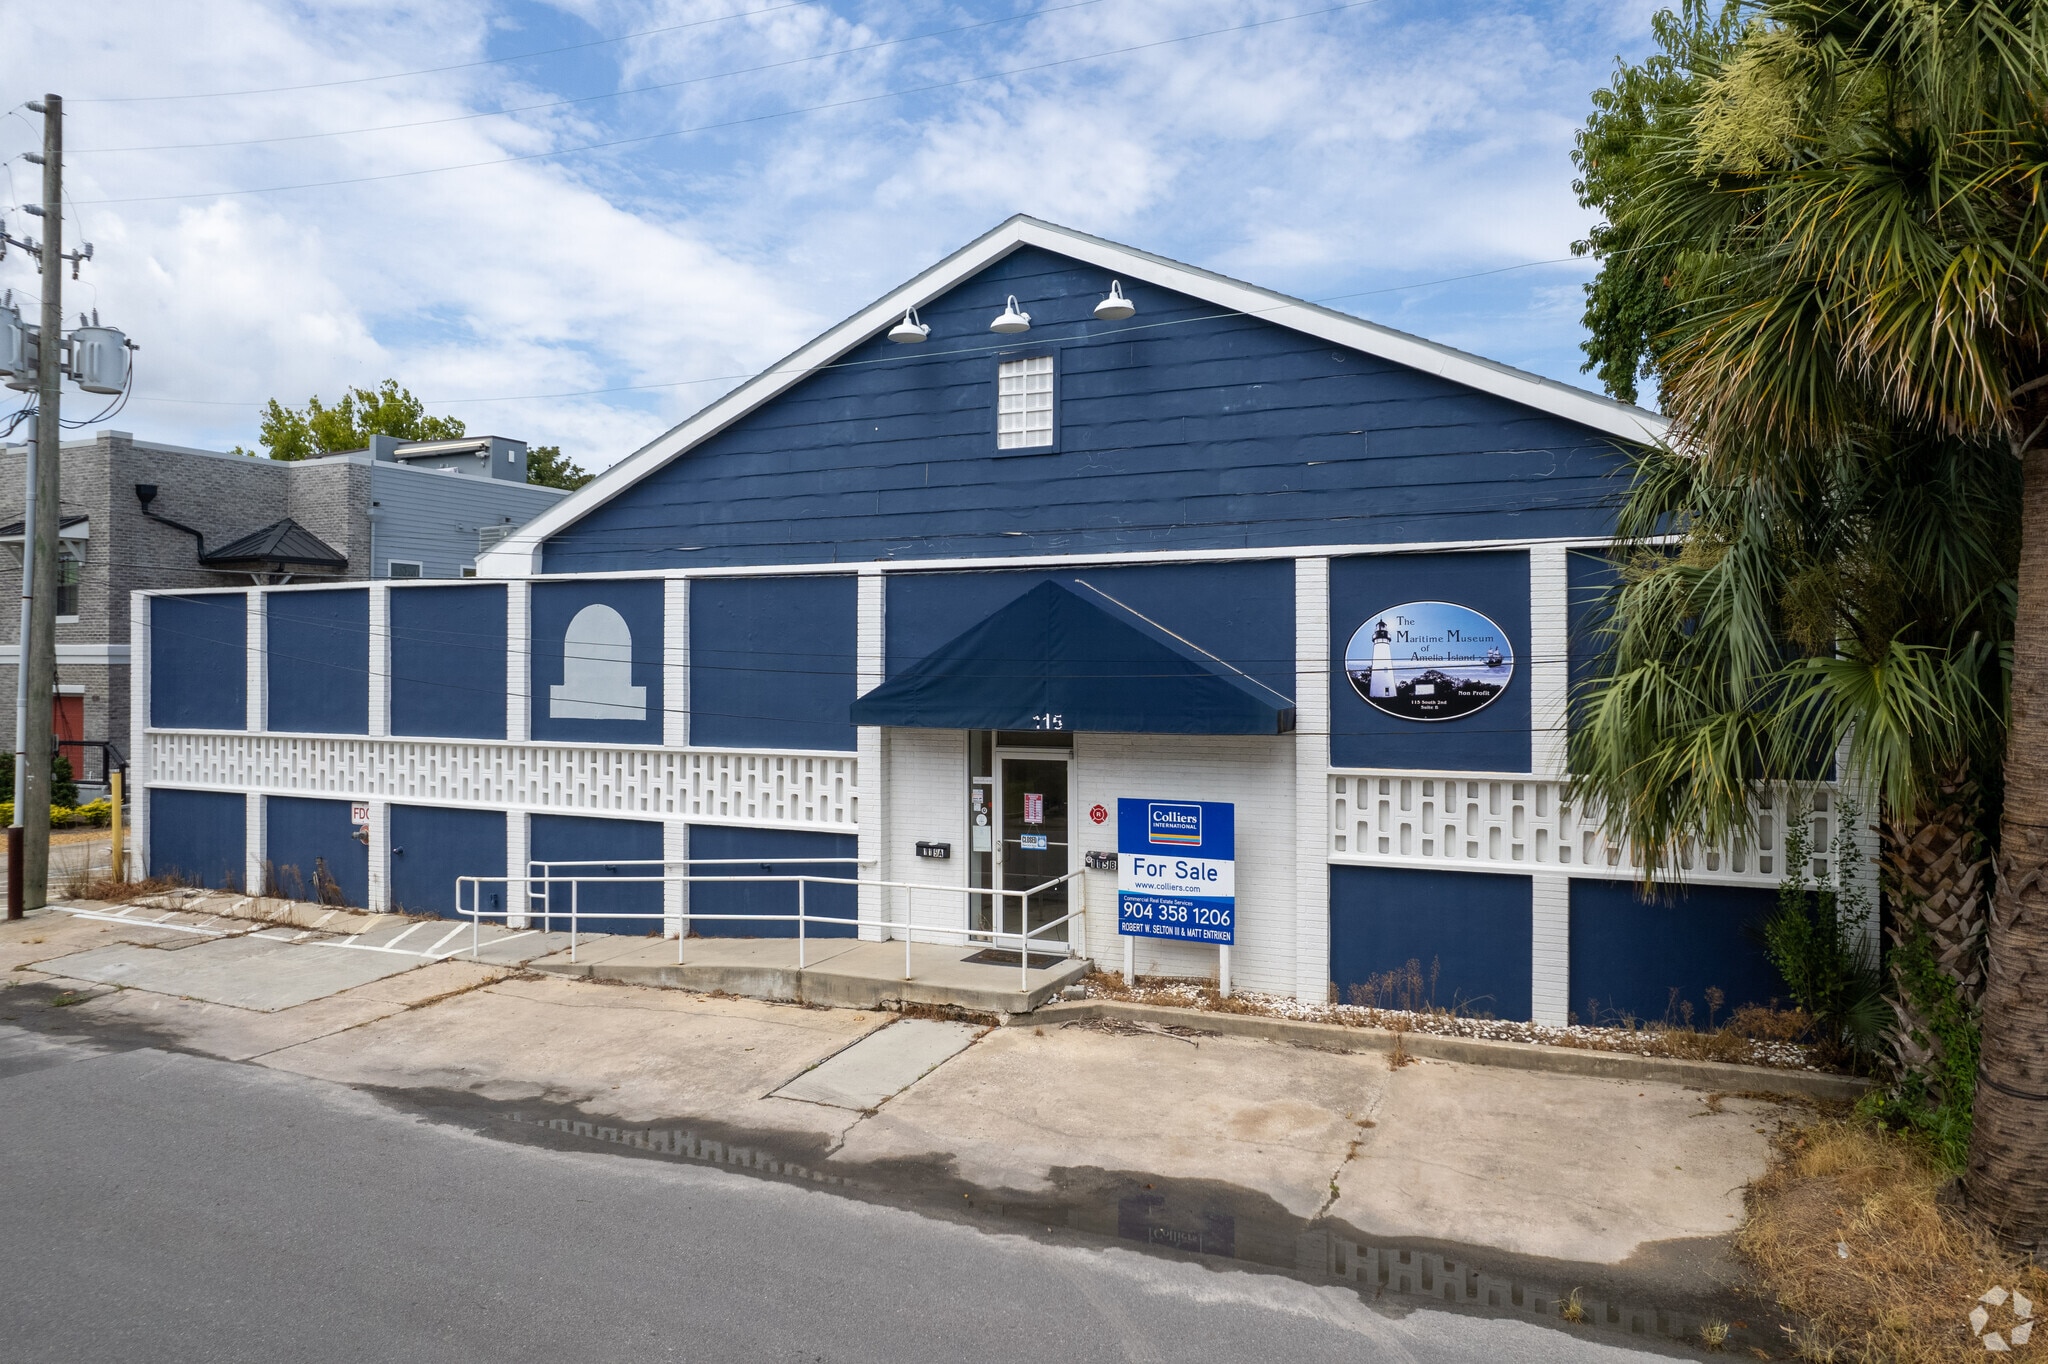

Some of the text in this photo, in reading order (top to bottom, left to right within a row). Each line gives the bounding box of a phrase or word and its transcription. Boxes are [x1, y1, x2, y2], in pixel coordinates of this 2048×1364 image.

[1396, 616, 1415, 626] The
[1396, 630, 1494, 642] Maritime Museum
[1410, 652, 1475, 661] Amelia Island
[1032, 713, 1062, 730] 115
[1153, 811, 1197, 823] Colliers
[1134, 858, 1218, 881] For Sale
[1135, 882, 1200, 892] www.colliers.com
[1123, 902, 1230, 926] 904 358 1206
[1122, 922, 1143, 932] ROBERT
[1144, 924, 1151, 933] W.
[1152, 925, 1174, 935] SELTON
[1181, 927, 1186, 936] &
[1187, 928, 1202, 938] MATT
[1203, 930, 1231, 941] ENTRIKEN
